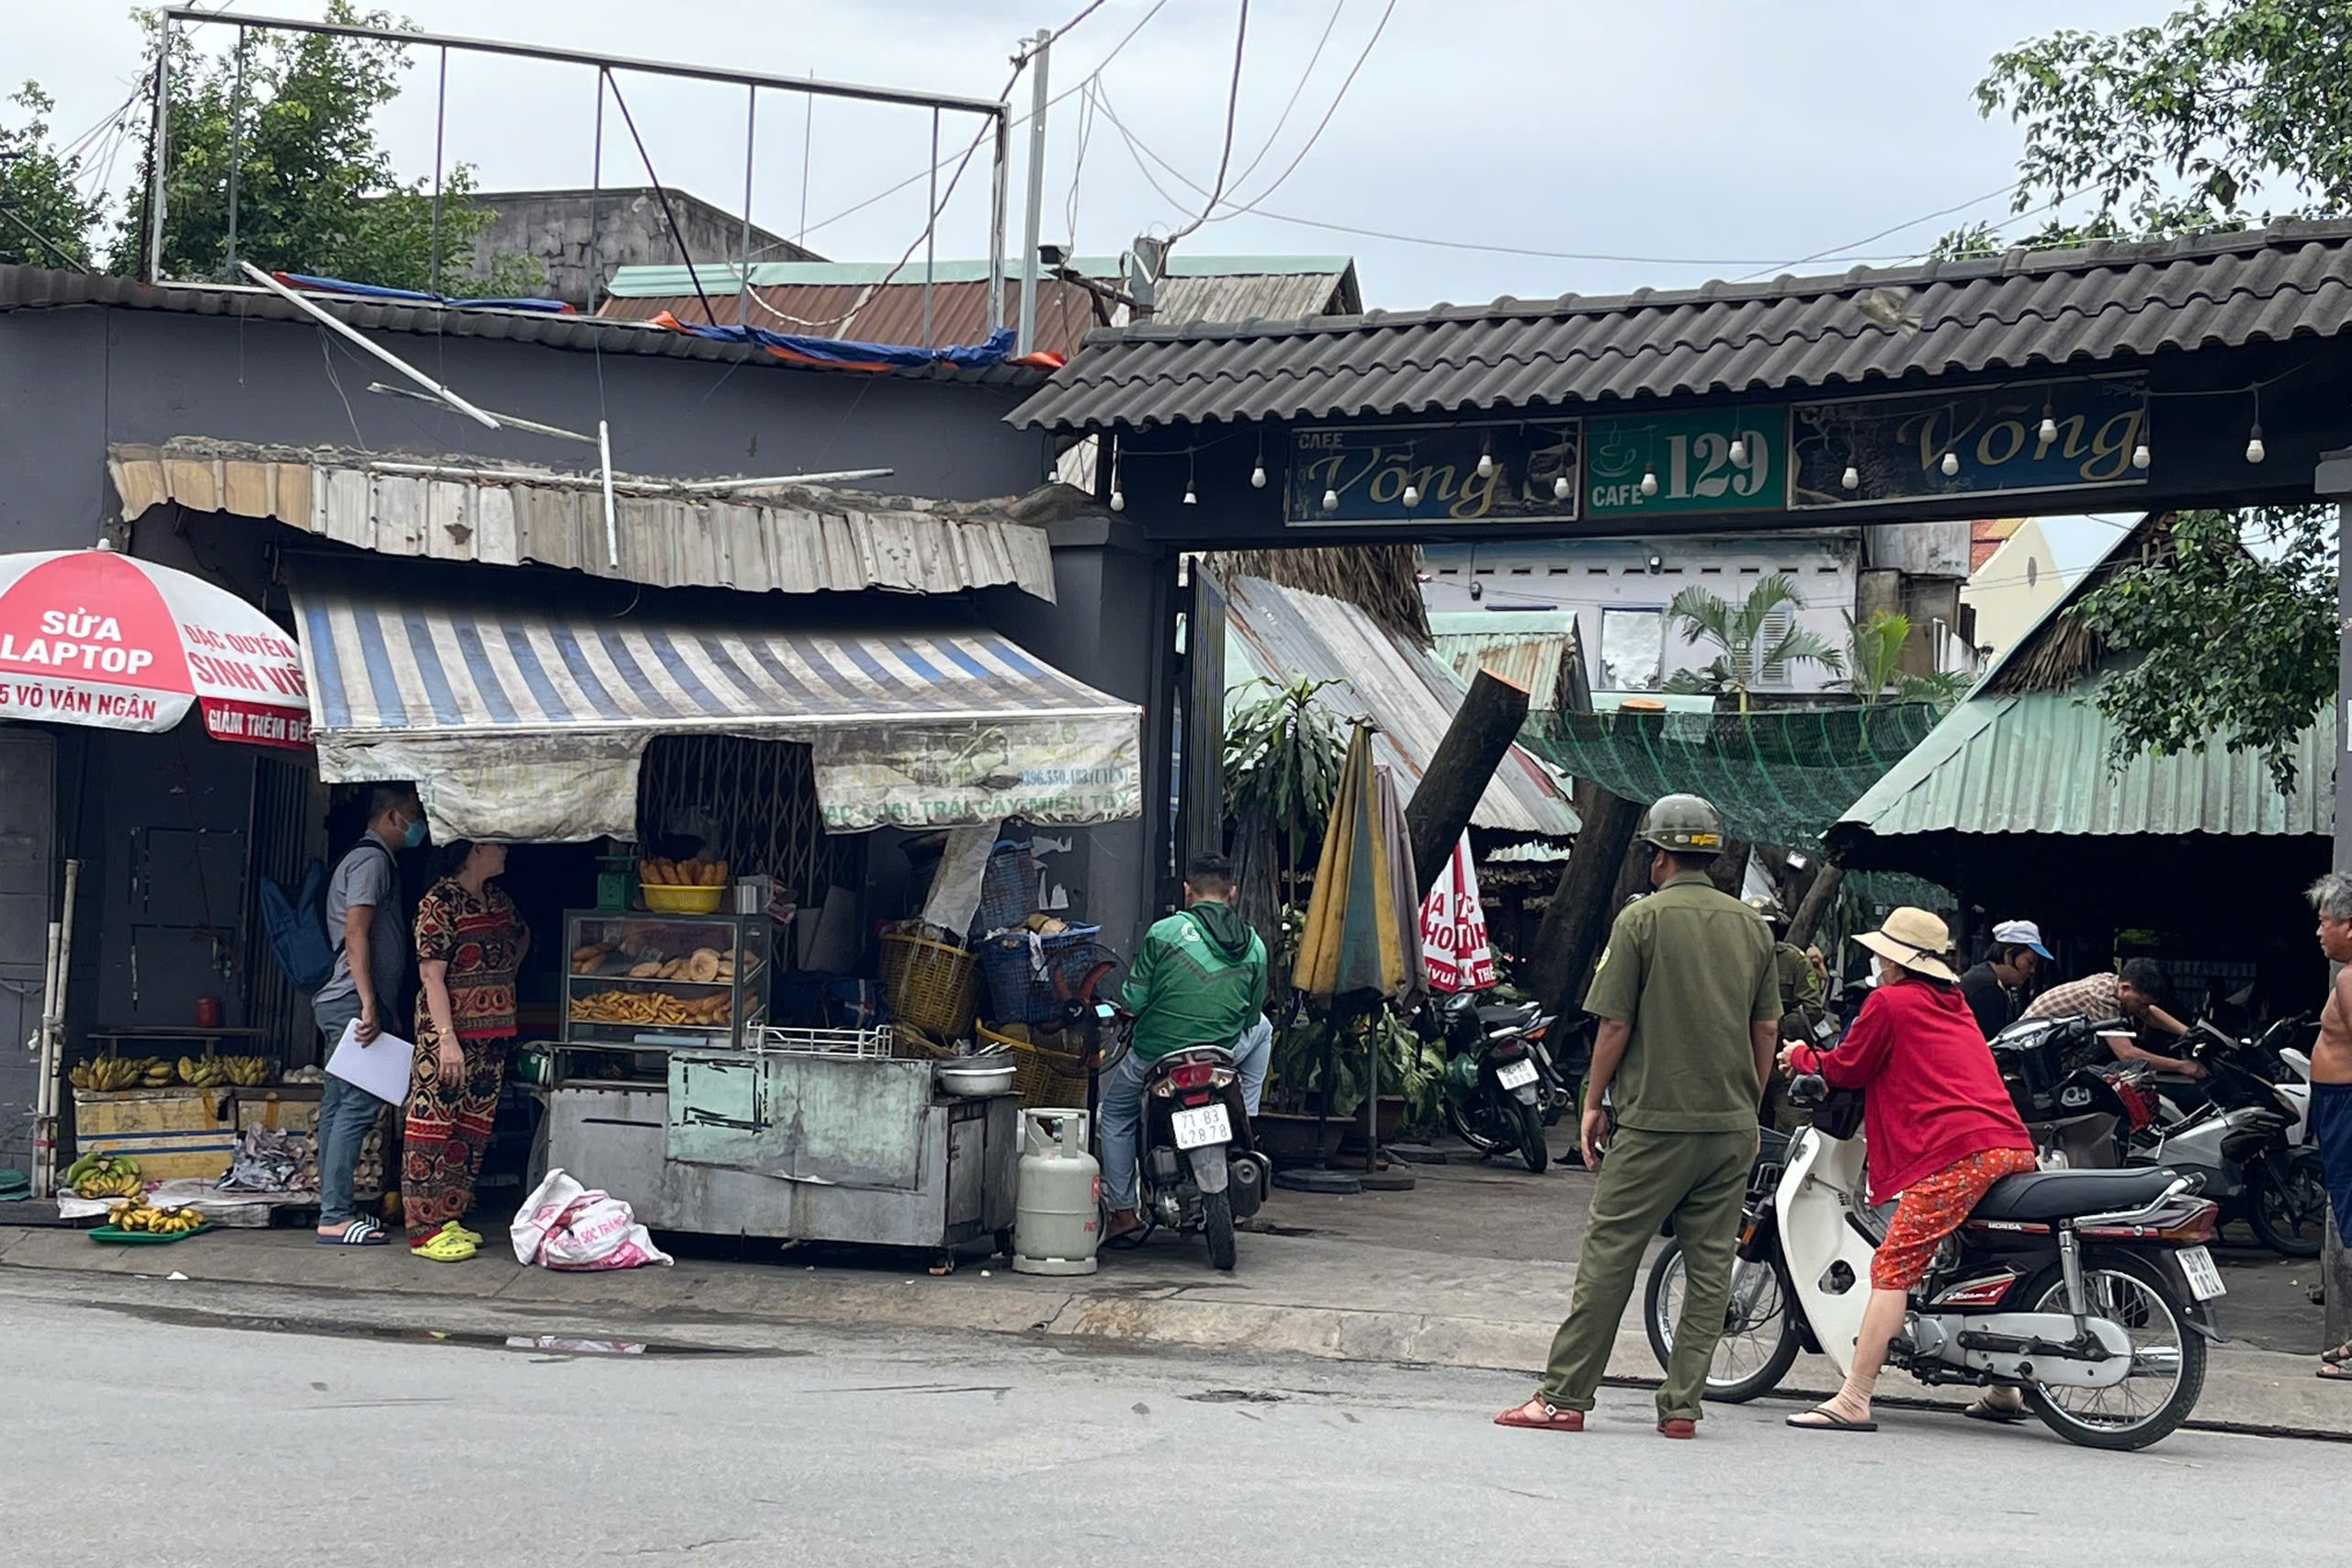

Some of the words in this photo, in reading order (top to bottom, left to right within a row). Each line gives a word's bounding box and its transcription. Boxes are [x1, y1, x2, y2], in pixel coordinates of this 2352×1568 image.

[1297, 433, 1344, 449] CAFE
[1307, 446, 1504, 520] Võng
[1664, 430, 1770, 500] 129
[1591, 483, 1644, 506] CAFE
[40, 606, 122, 642] SỬA
[182, 623, 227, 651] ĐẶC
[0, 633, 154, 675] LAPTOP
[187, 650, 268, 693] SINH
[17, 682, 43, 708] VÕ
[50, 685, 92, 714] VĂN
[97, 693, 157, 720] NGÂN
[246, 711, 286, 740] THÊM
